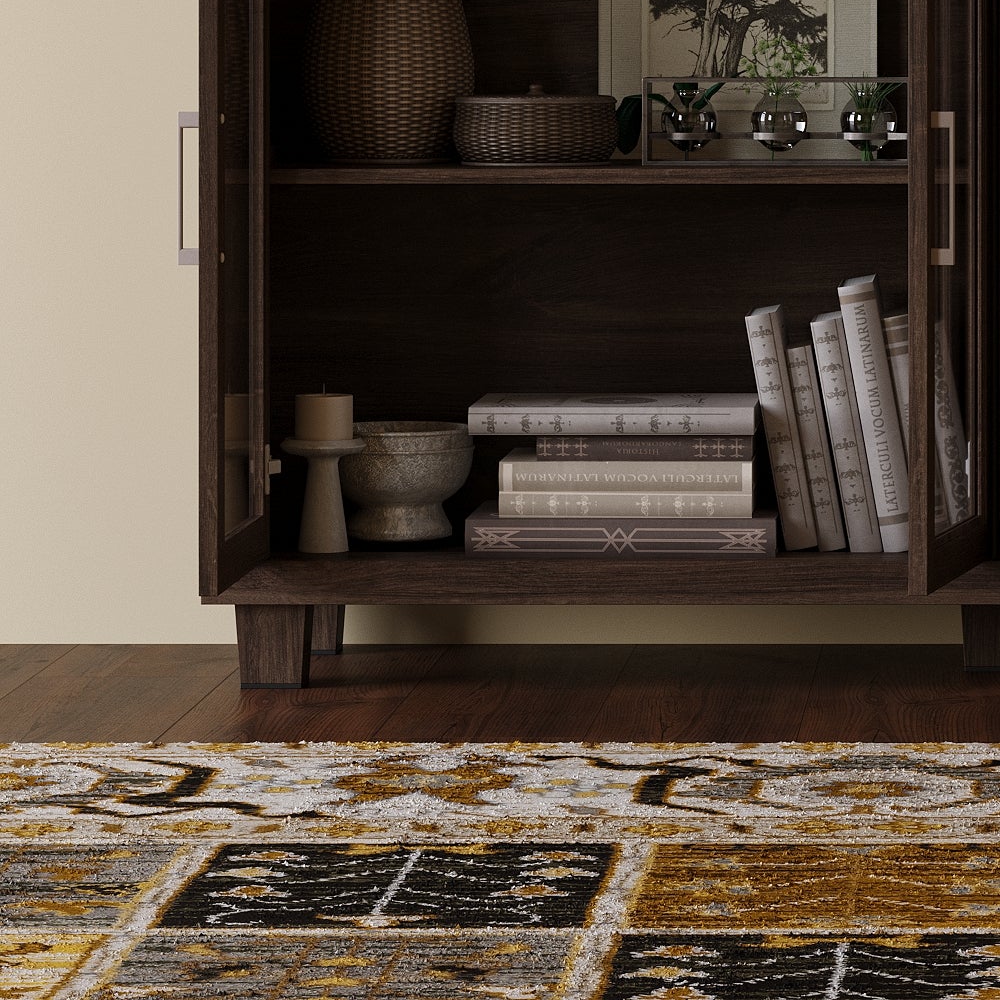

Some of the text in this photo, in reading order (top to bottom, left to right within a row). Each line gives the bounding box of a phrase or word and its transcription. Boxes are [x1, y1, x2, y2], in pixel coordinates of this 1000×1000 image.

[854, 303, 899, 513] LATERCULI VOCUM LATINARUM
[515, 473, 739, 484] LATERCULI VOCUM LATINARUM
